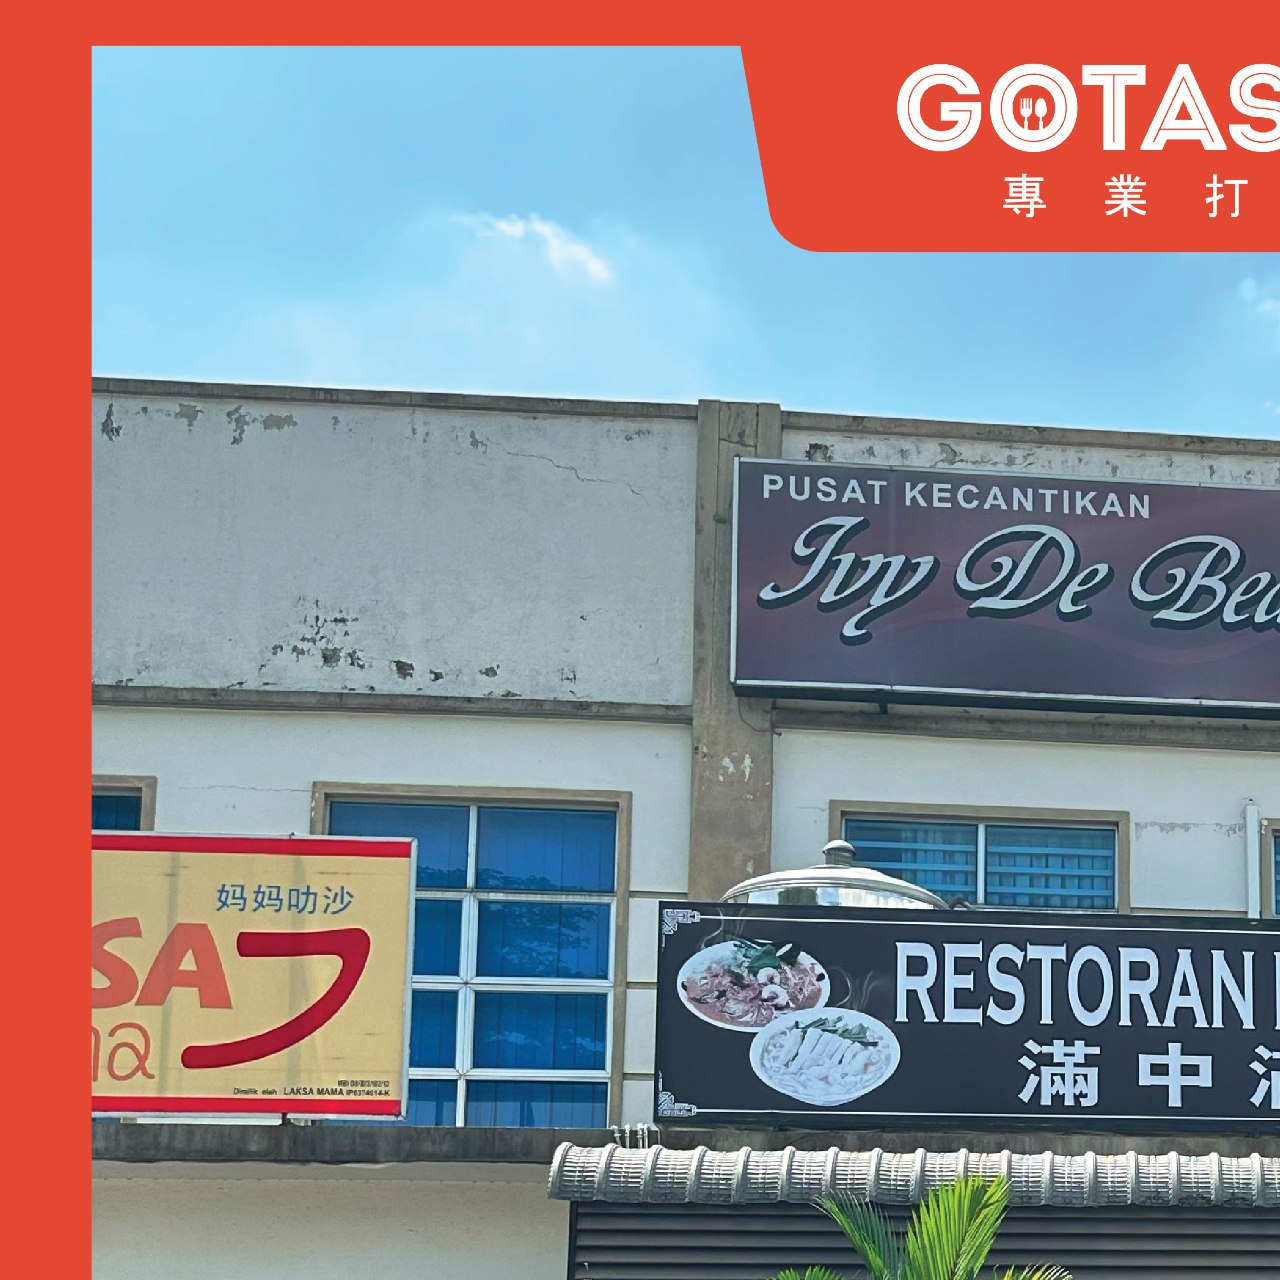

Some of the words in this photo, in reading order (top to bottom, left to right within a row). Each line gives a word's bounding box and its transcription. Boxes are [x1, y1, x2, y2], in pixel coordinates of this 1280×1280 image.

[763, 474, 887, 504] PUSAT
[904, 482, 1151, 519] KECANTIKAN
[758, 516, 940, 644] Ivy
[954, 524, 1115, 622] De
[216, 883, 354, 915] 妈妈叻沙
[895, 940, 1256, 1031] RESTORAN
[283, 1087, 315, 1096] LAKSA
[316, 1087, 344, 1096] MAMA
